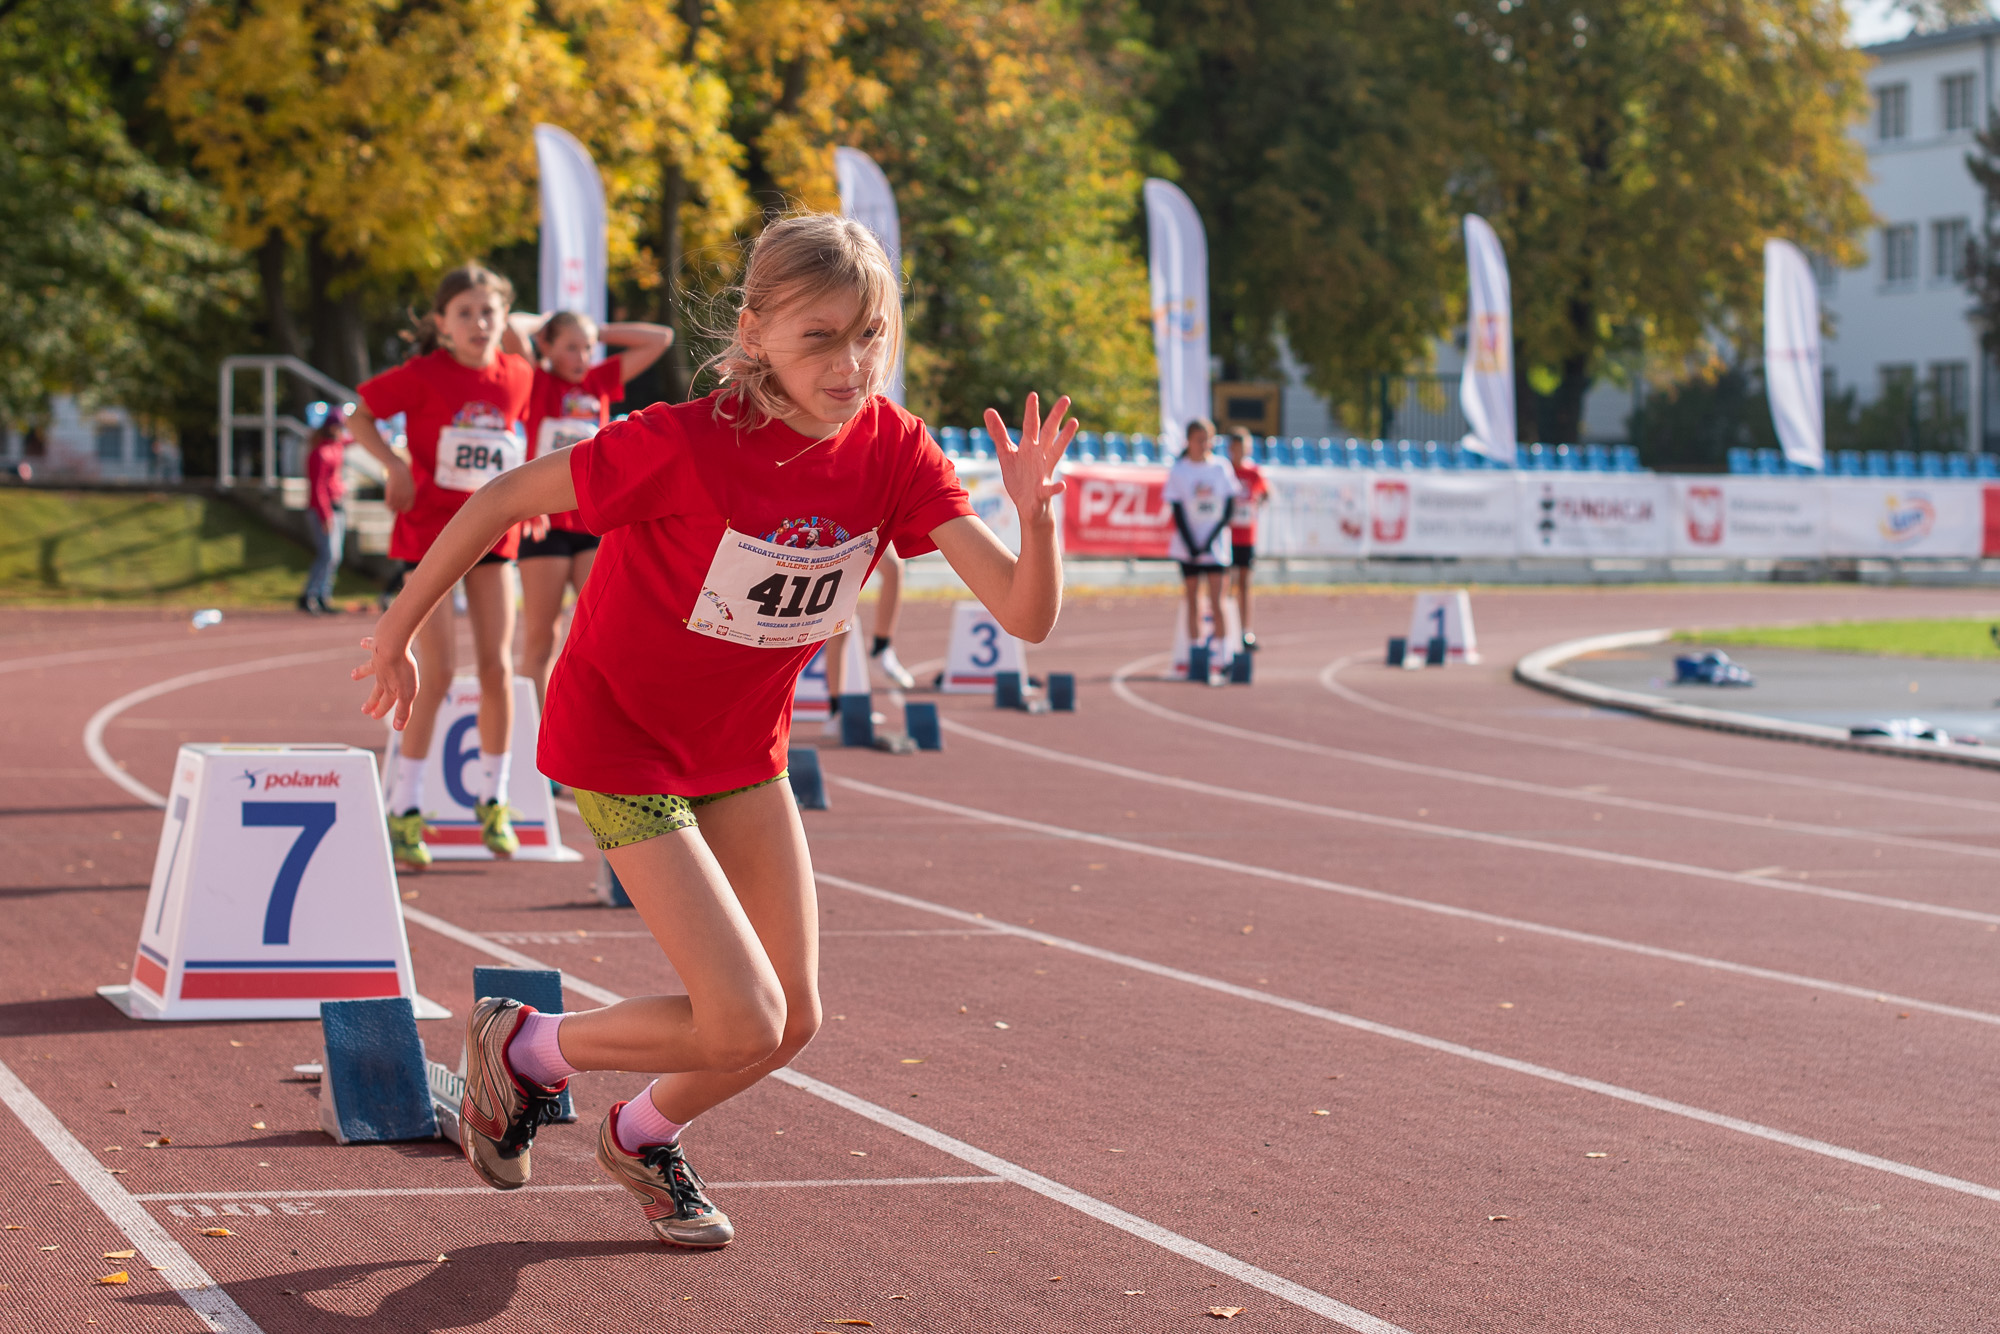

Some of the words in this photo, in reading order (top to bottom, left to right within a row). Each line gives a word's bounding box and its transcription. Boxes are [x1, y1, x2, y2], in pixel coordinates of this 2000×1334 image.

[456, 445, 503, 471] 284
[738, 541, 810, 564] LEKKOATLETYCZNE
[776, 560, 809, 570] NAJLEPSI
[747, 568, 844, 618] 410
[1429, 607, 1445, 638] 1
[972, 622, 998, 668] 3
[442, 714, 480, 809] 6
[264, 769, 341, 791] polanik
[242, 801, 336, 945] 7
